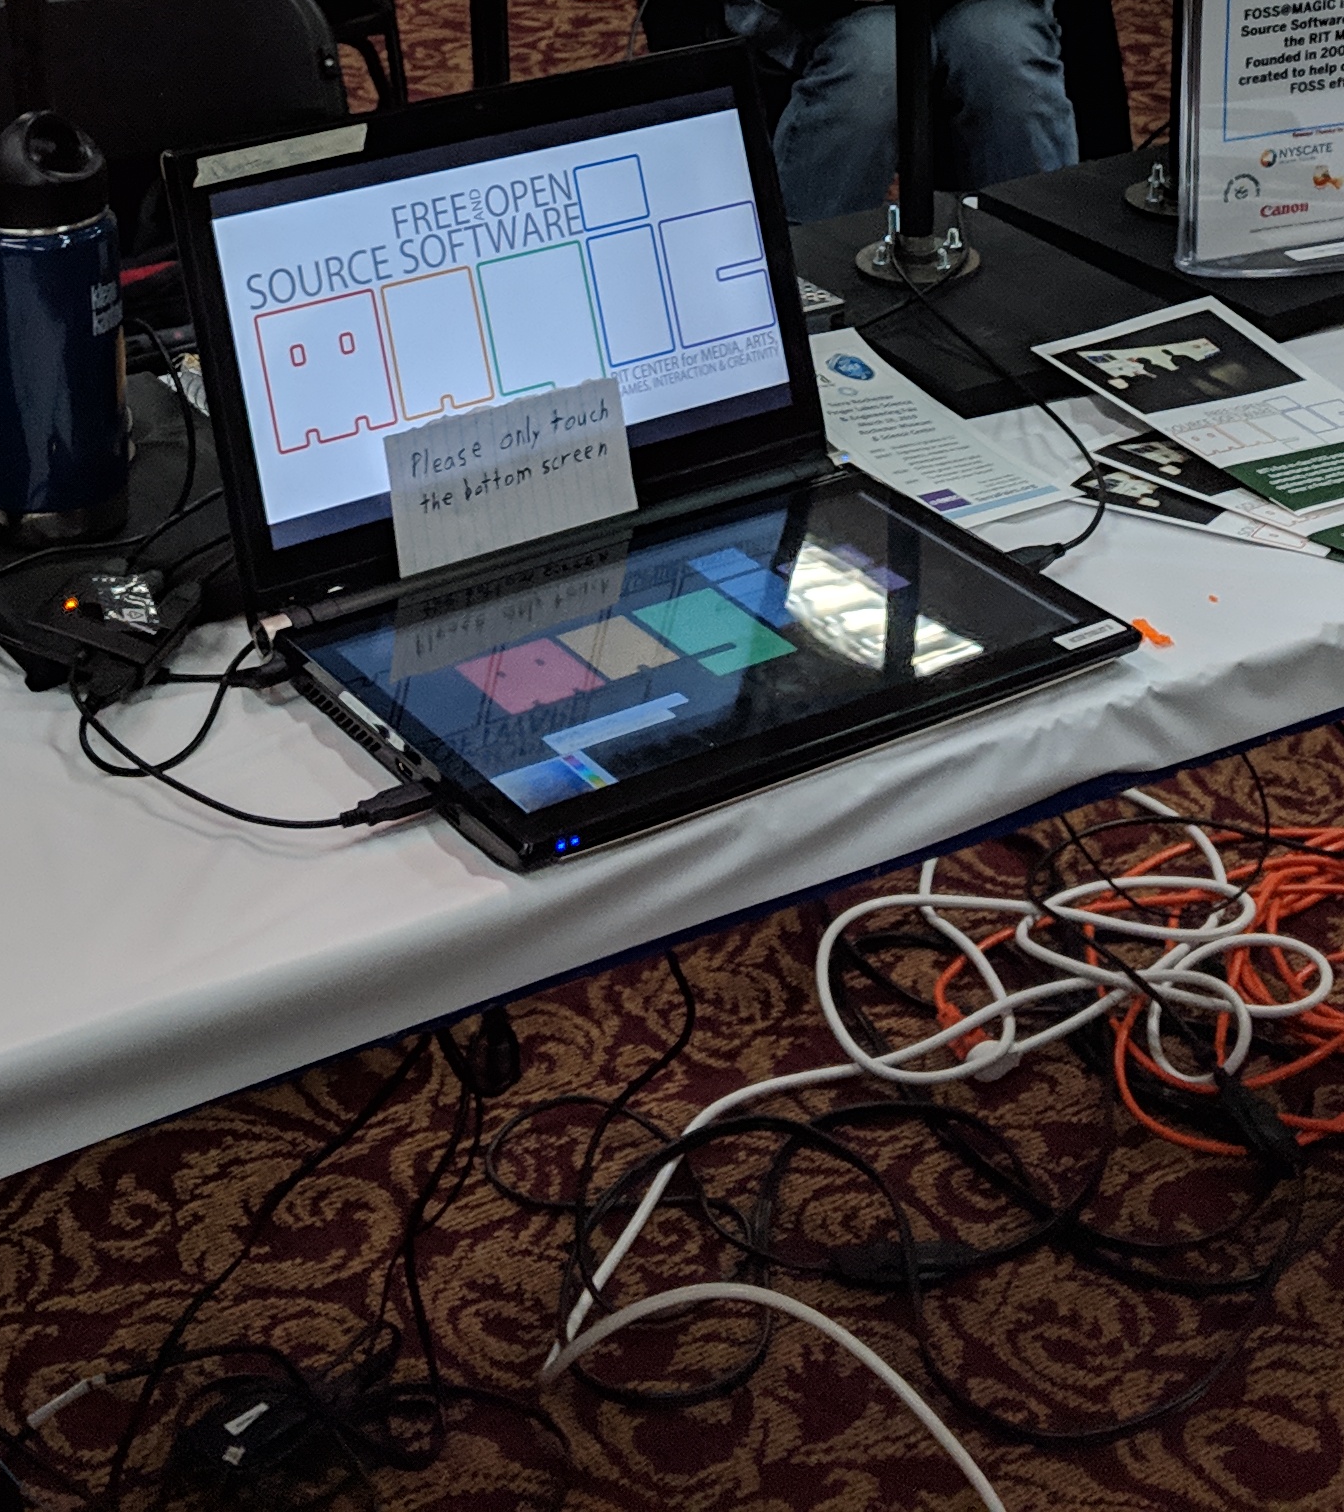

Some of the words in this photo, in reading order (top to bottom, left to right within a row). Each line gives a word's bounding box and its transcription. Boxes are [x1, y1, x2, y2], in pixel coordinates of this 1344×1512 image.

[1240, 23, 1287, 37] Source
[1284, 35, 1305, 49] the
[1309, 31, 1331, 45] RIT
[1245, 51, 1302, 69] Founded
[1305, 49, 1317, 61] in
[1238, 68, 1289, 86] created
[1292, 65, 1306, 78] to
[1309, 61, 1338, 79] help
[1290, 78, 1326, 95] FOSS
[1279, 142, 1333, 158] NYSCATE
[390, 191, 471, 239] FREE
[468, 187, 486, 222] AND
[483, 169, 574, 218] OPEN
[1259, 202, 1309, 219] Canon
[246, 245, 393, 311] SOURCE
[398, 202, 585, 274] SOFTWARE
[632, 355, 679, 380] CENTER
[681, 352, 699, 367] for
[654, 364, 716, 388] INTERACTION
[718, 360, 727, 372] &
[727, 345, 780, 369] CREATIVITY
[411, 441, 482, 478] Please
[499, 415, 540, 450] only
[550, 398, 610, 430] touch
[419, 489, 453, 514] the
[464, 465, 532, 501] bottom
[542, 441, 608, 475] screen
